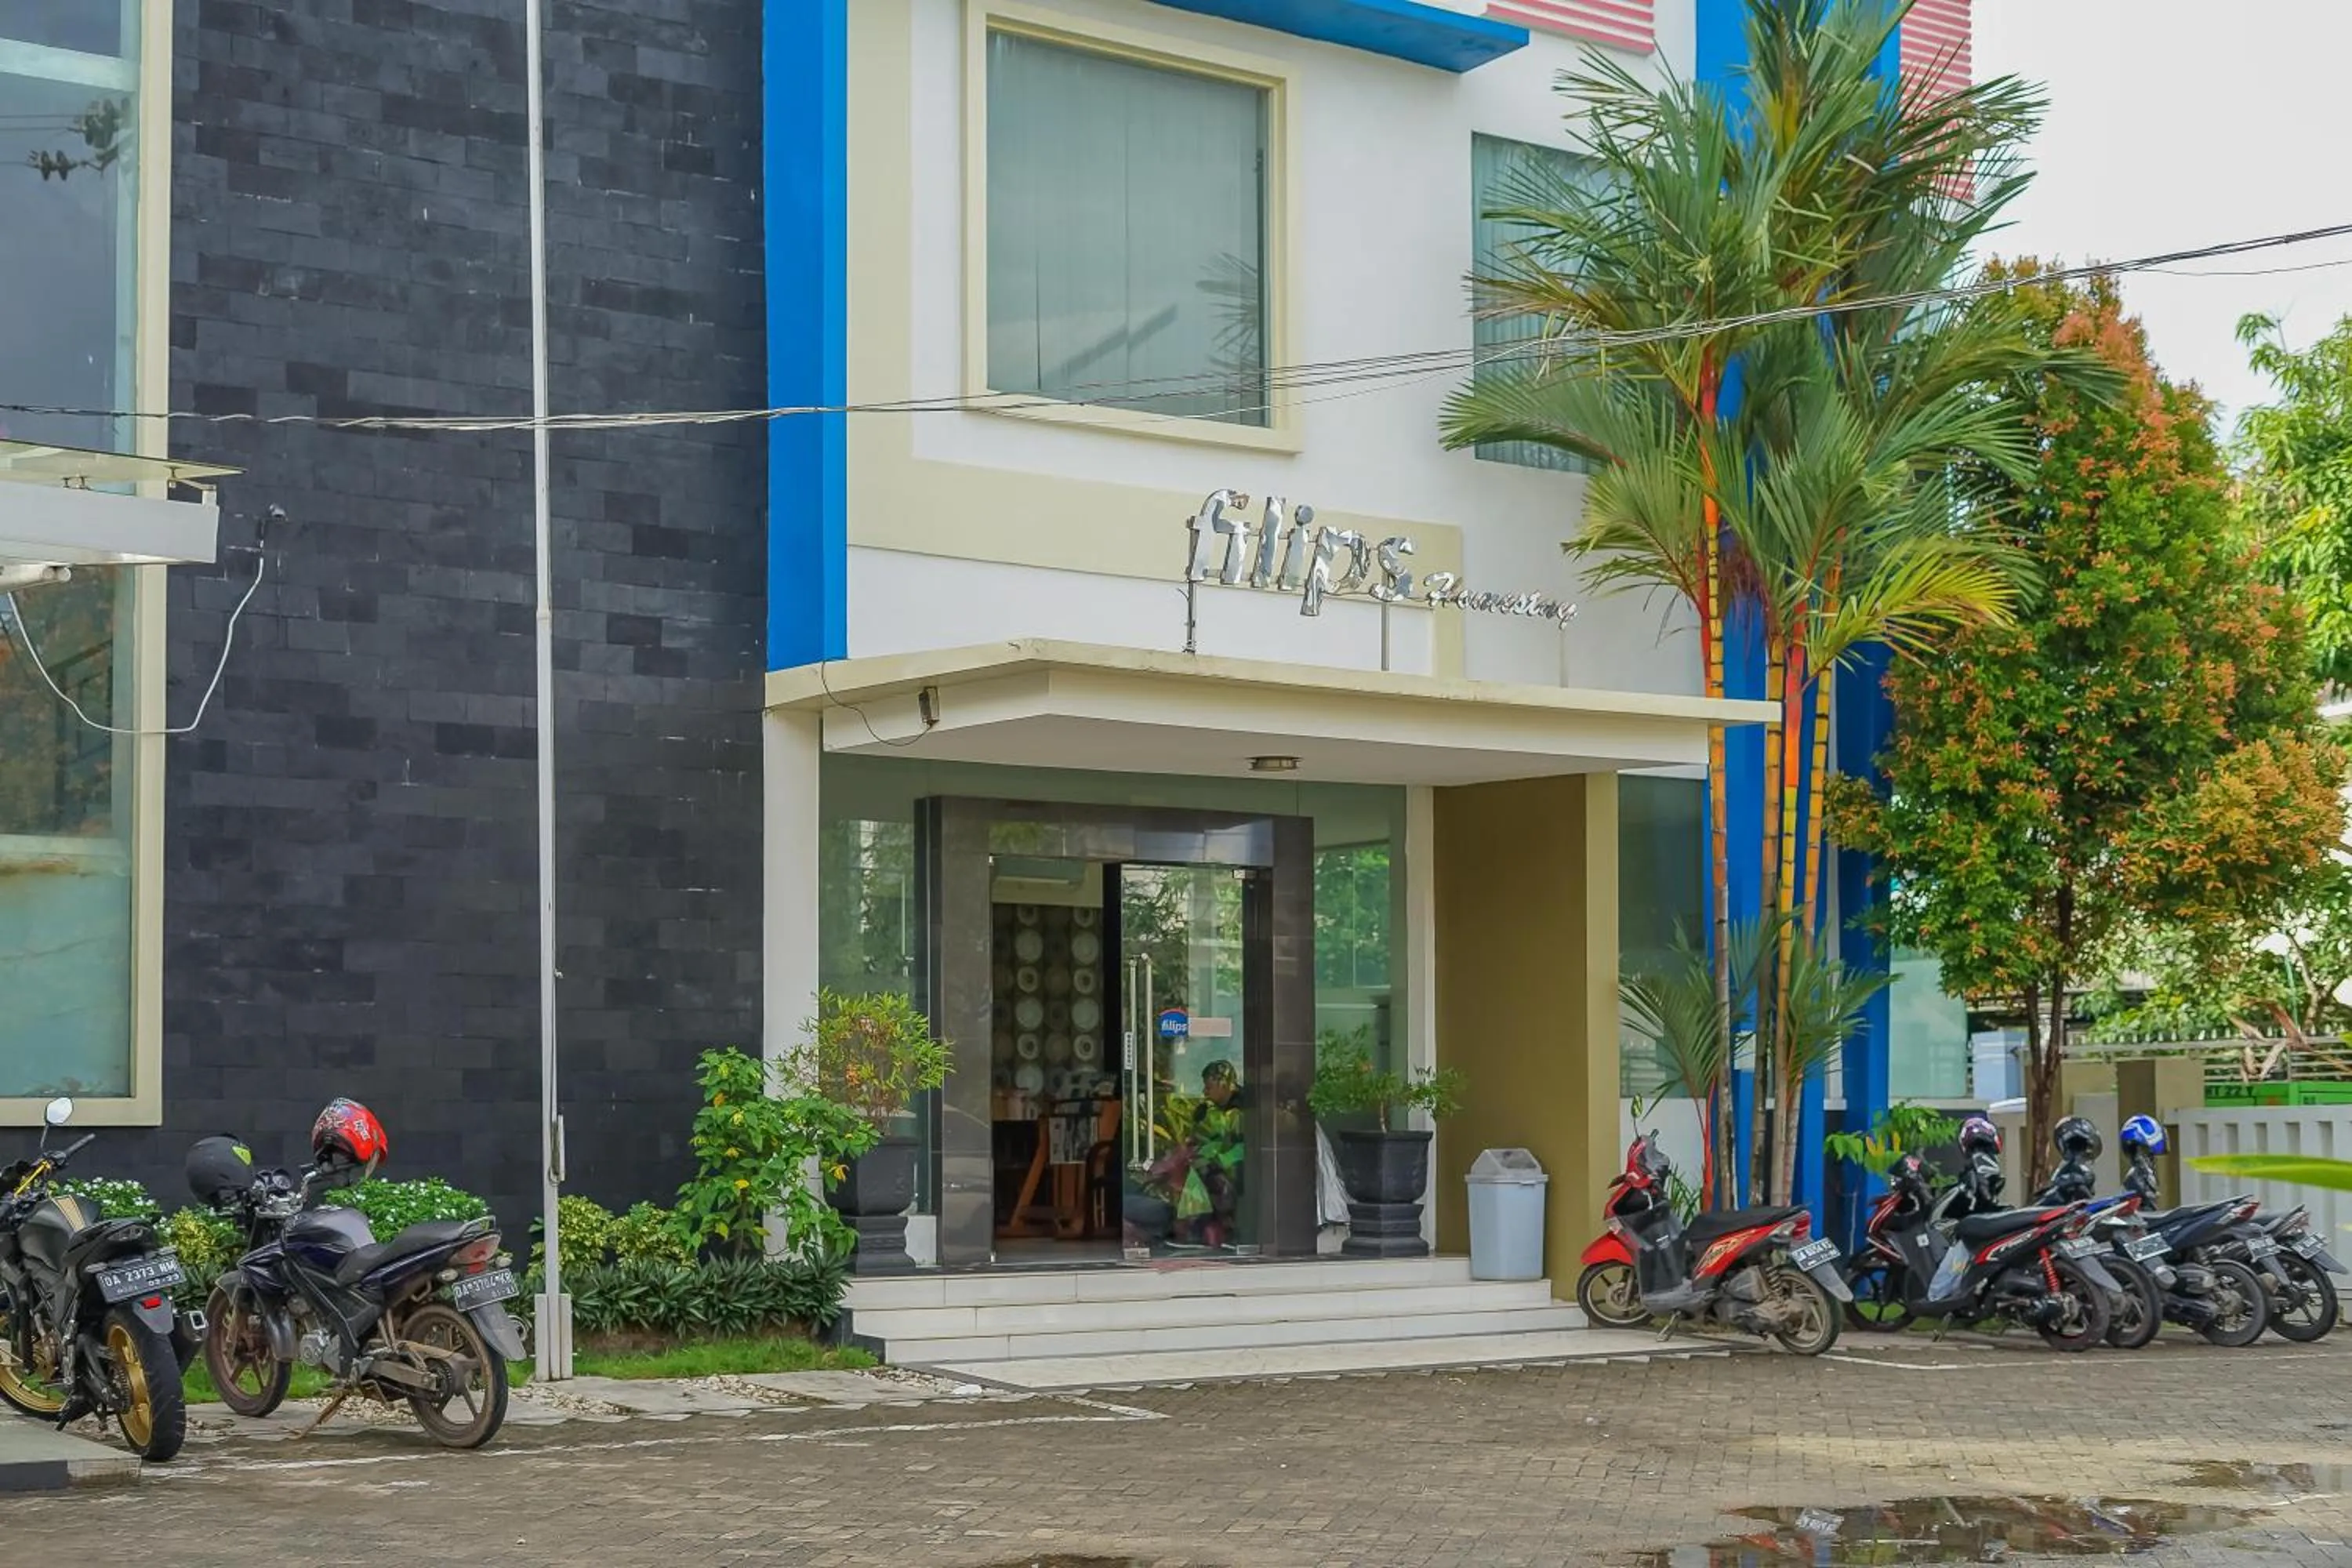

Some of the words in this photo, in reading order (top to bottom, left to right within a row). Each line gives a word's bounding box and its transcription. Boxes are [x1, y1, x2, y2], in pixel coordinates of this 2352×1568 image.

[1187, 488, 1414, 617] filips
[1161, 1018, 1188, 1033] filips
[125, 1266, 154, 1282] 2373
